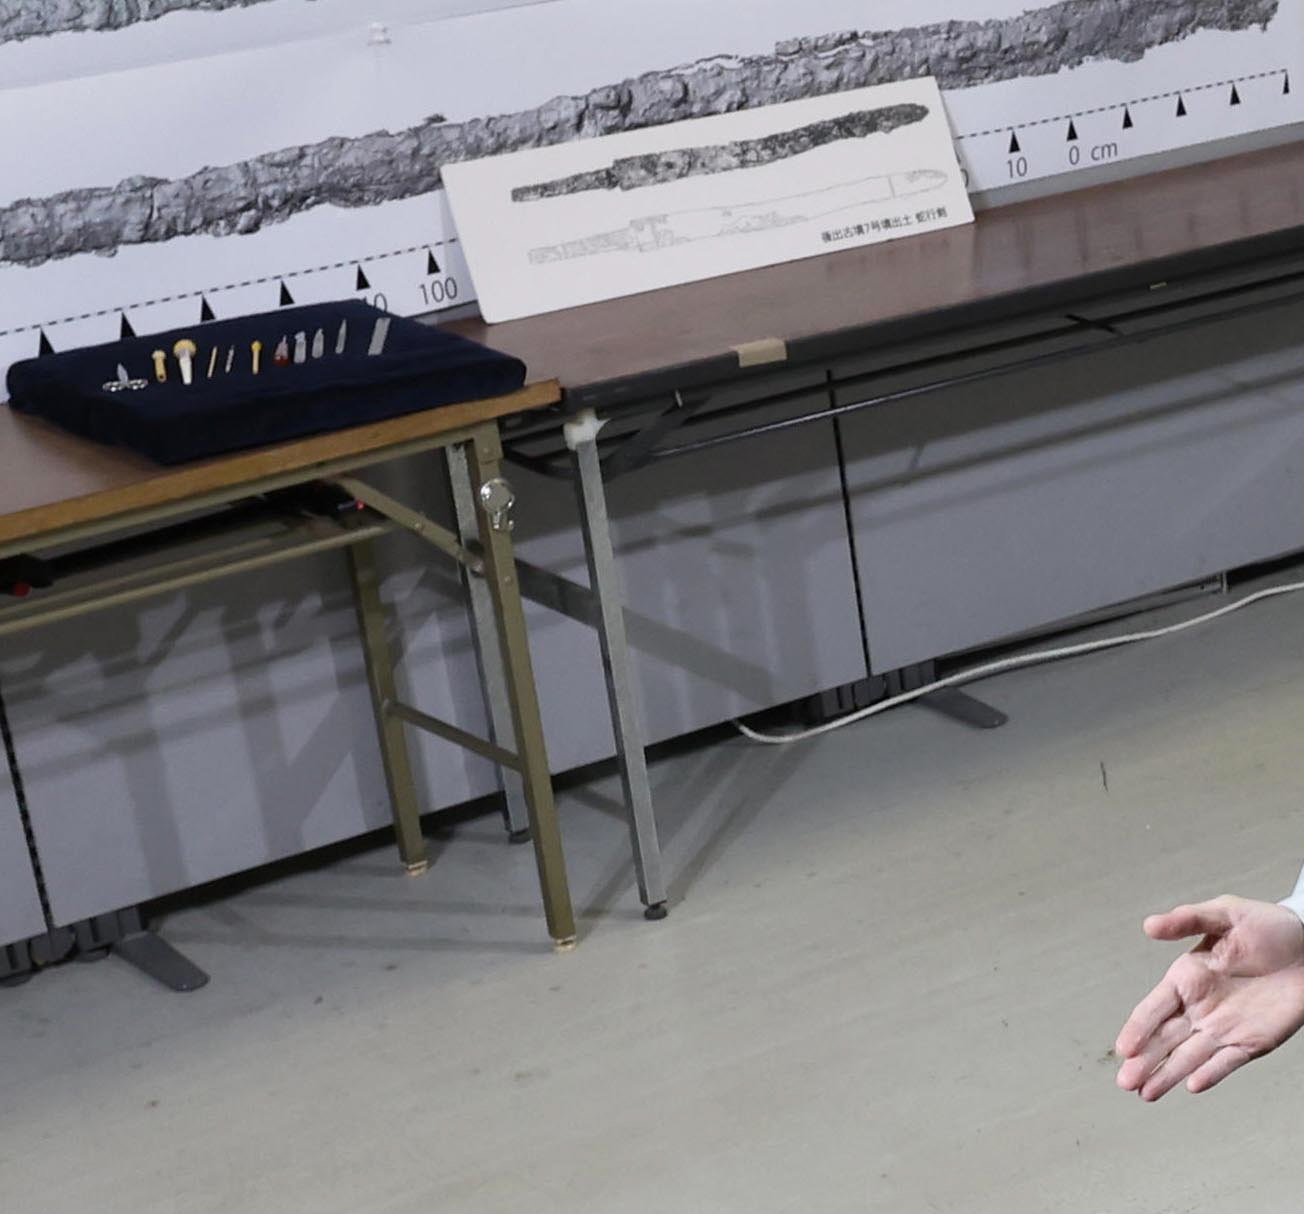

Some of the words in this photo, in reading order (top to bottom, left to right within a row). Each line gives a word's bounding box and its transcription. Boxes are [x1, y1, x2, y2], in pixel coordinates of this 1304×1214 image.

[1068, 145, 1080, 166] 0
[1090, 142, 1118, 161] cm
[1006, 156, 1028, 179] 10
[420, 277, 458, 306] 100
